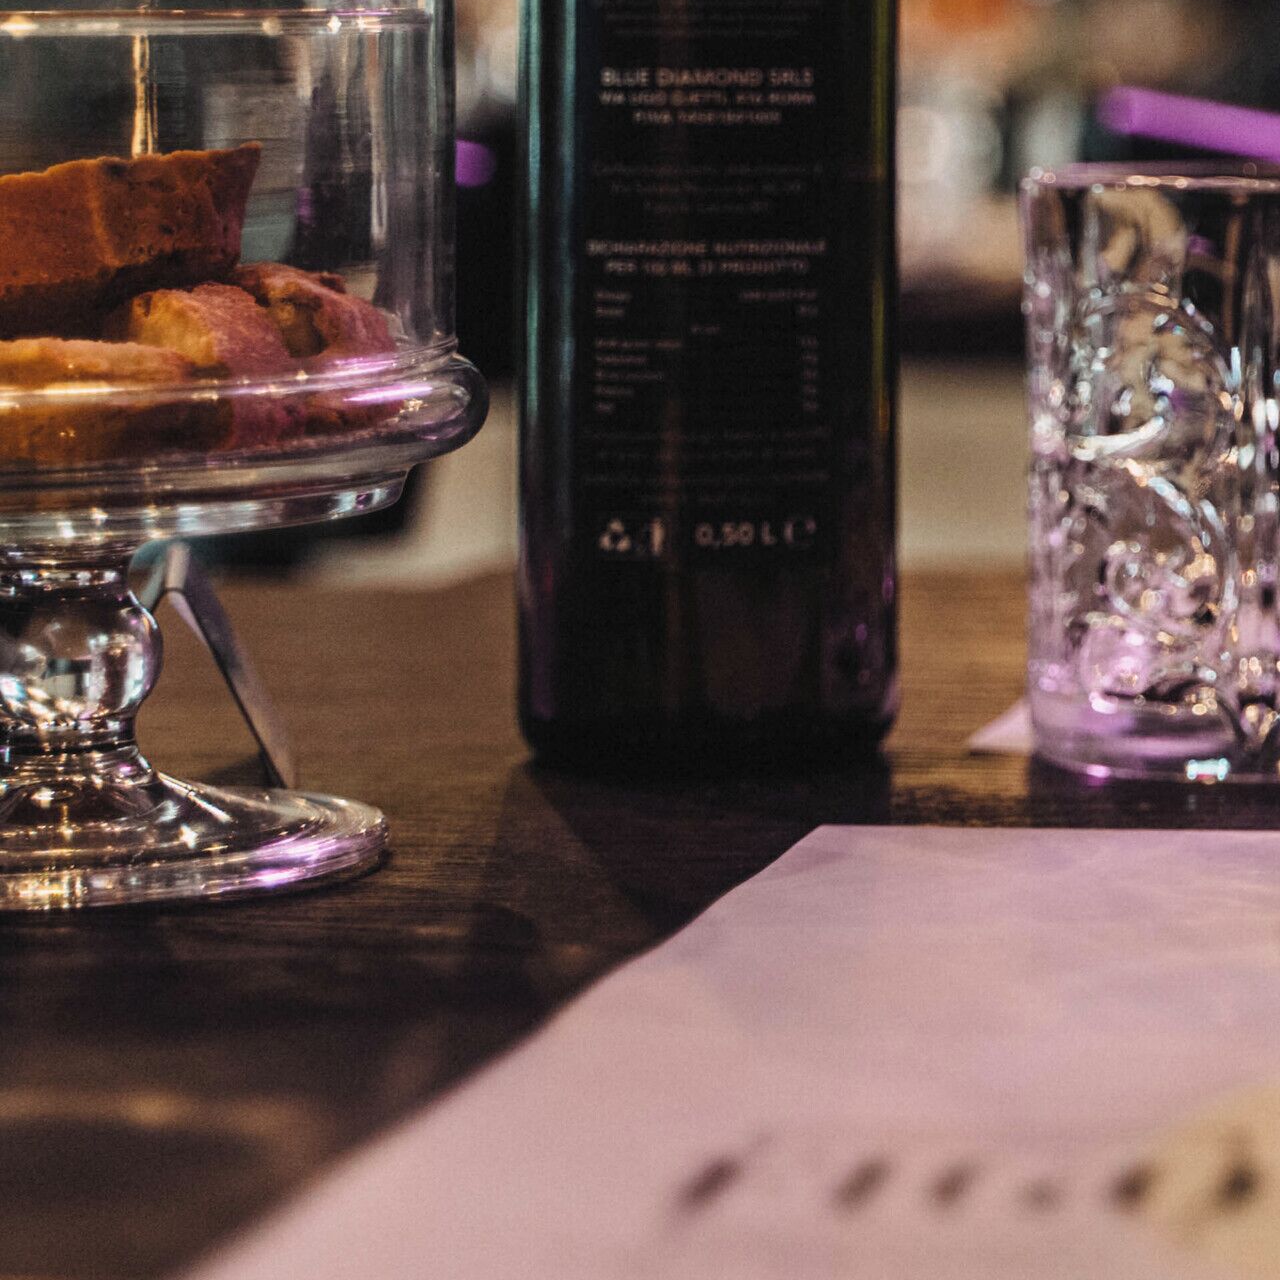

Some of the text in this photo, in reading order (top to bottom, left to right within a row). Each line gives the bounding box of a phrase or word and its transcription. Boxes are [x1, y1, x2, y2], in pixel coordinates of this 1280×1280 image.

[600, 68, 649, 86] BLUE
[654, 68, 763, 86] DIAMOND
[695, 522, 755, 548] 0,50
